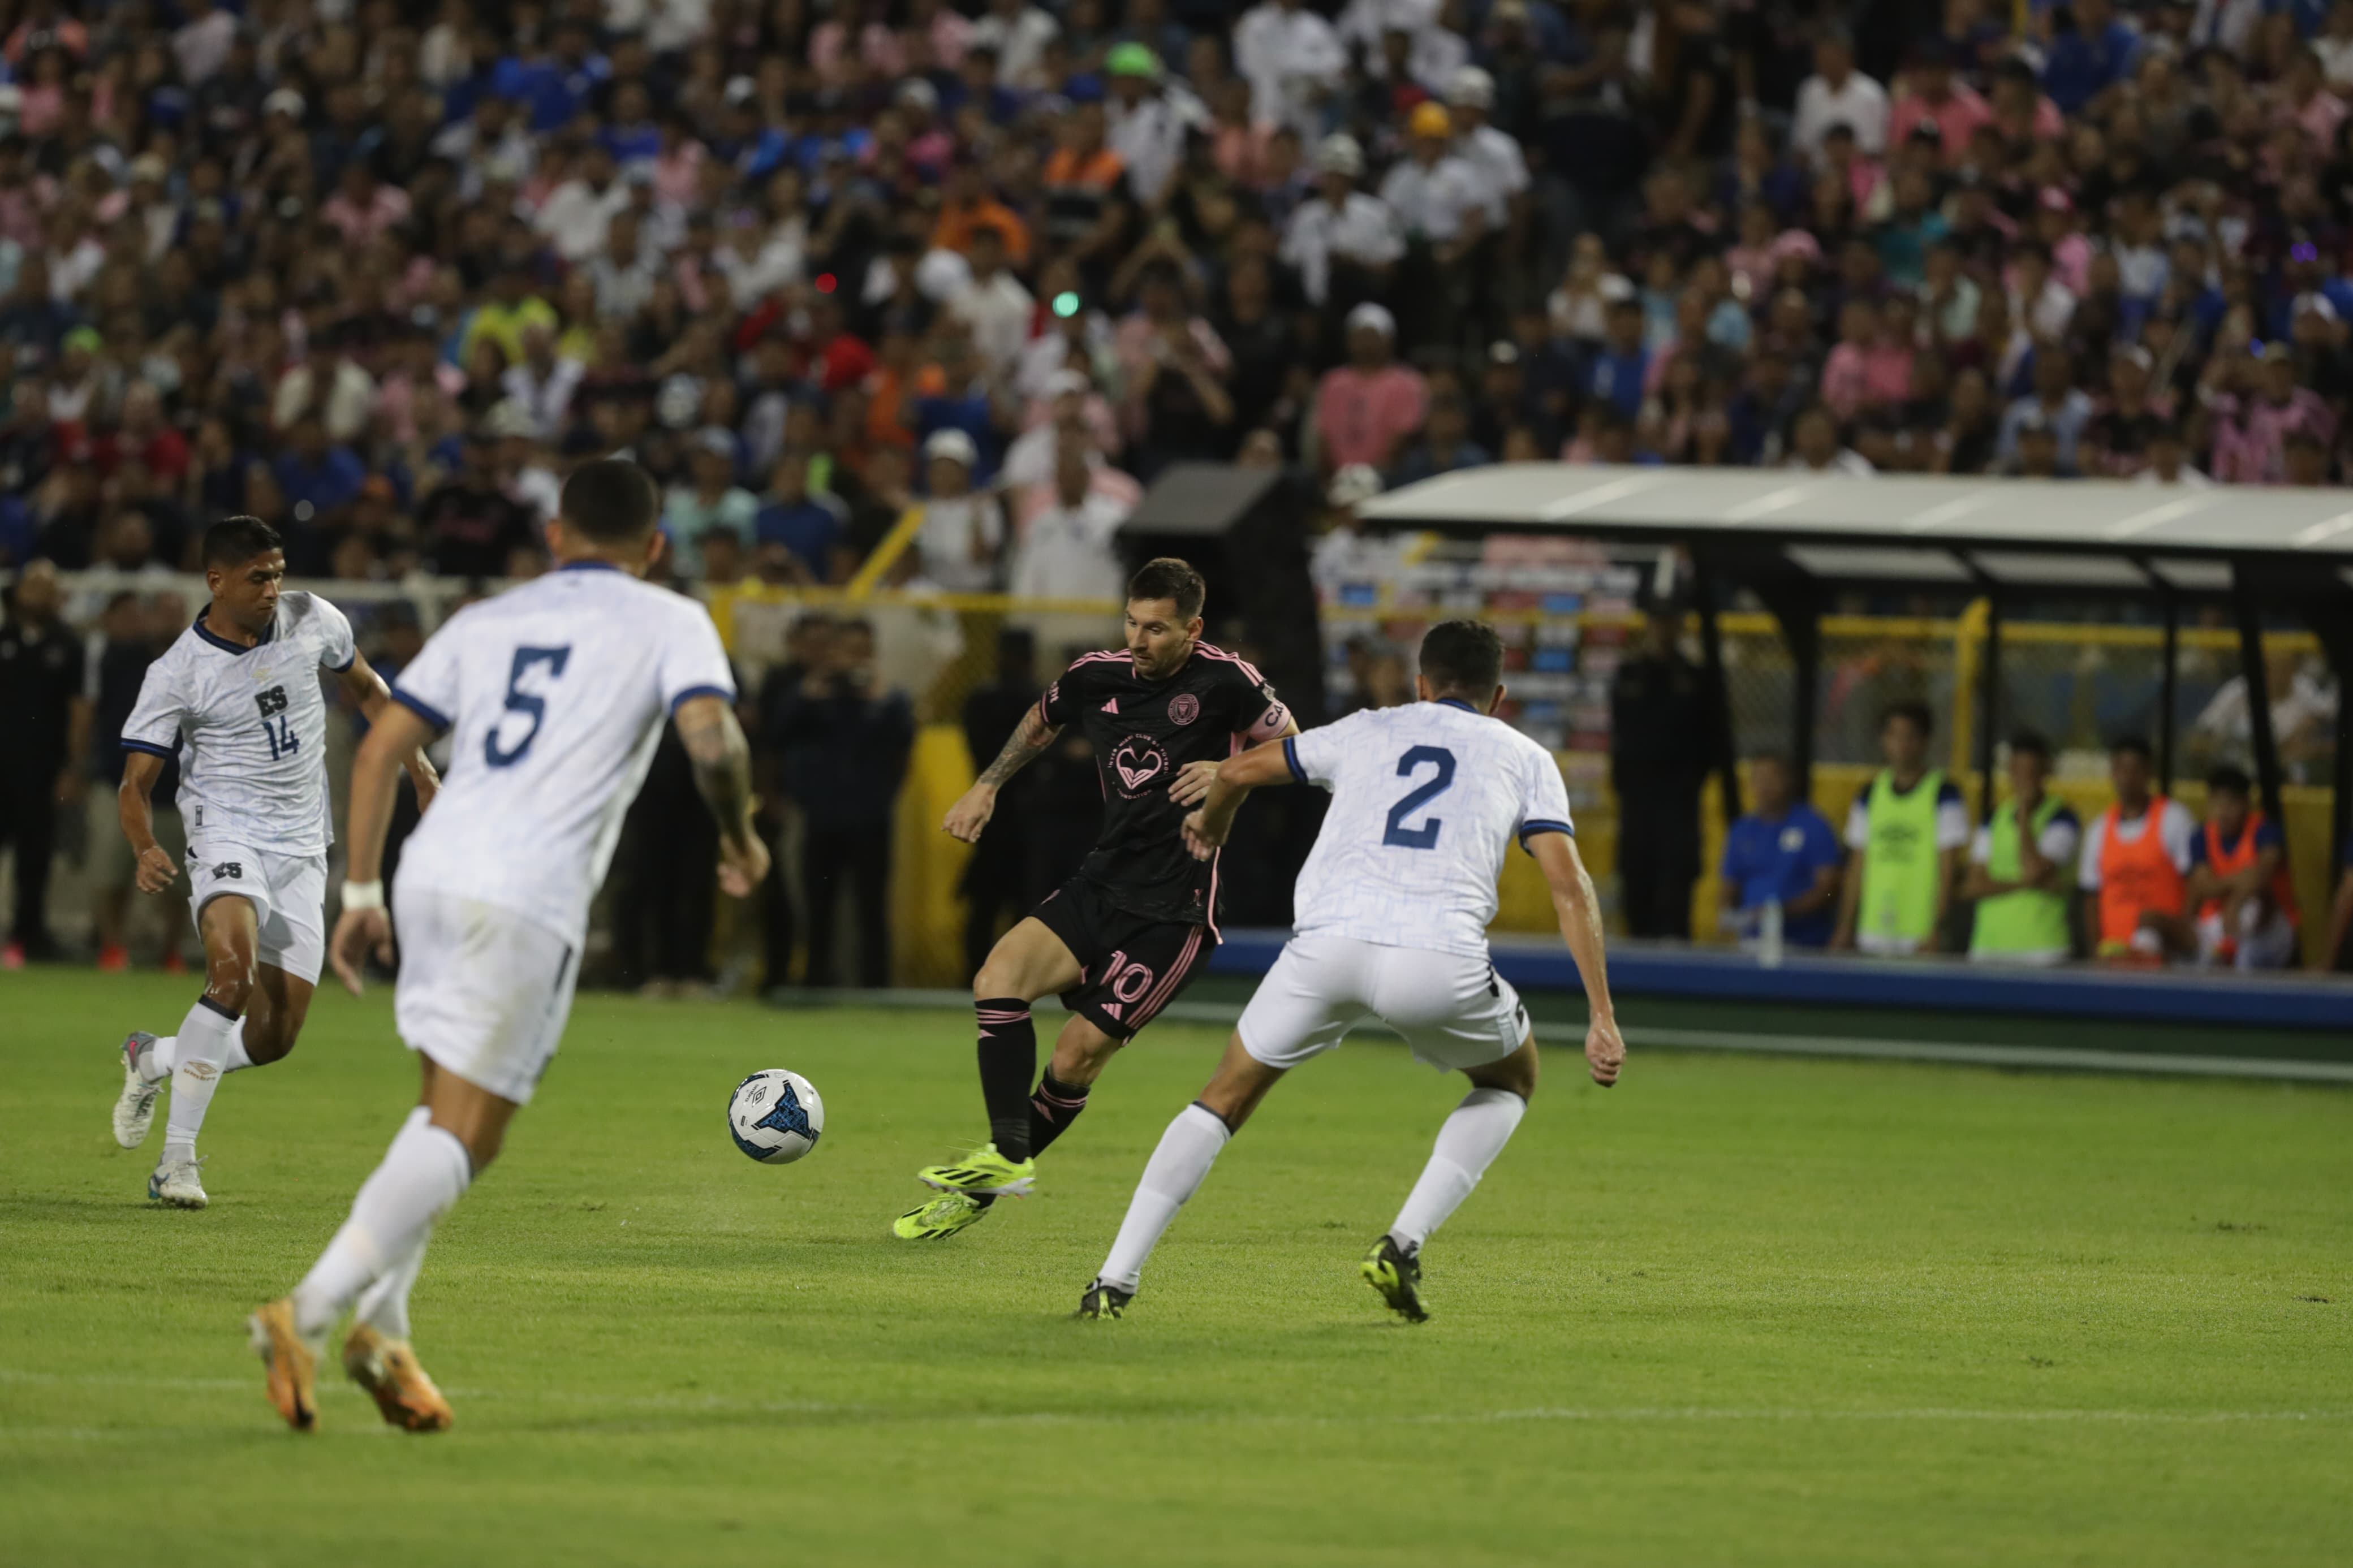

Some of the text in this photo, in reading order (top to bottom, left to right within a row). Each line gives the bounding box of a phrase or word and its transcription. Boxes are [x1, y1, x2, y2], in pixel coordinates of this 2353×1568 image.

[255, 685, 288, 718] ES
[485, 646, 573, 767] 5
[1264, 701, 1284, 727] CA
[262, 715, 299, 761] 14
[1382, 745, 1456, 850] 2
[212, 861, 242, 882] ES
[1100, 950, 1153, 1003] 10
[745, 1084, 759, 1102] umbro
